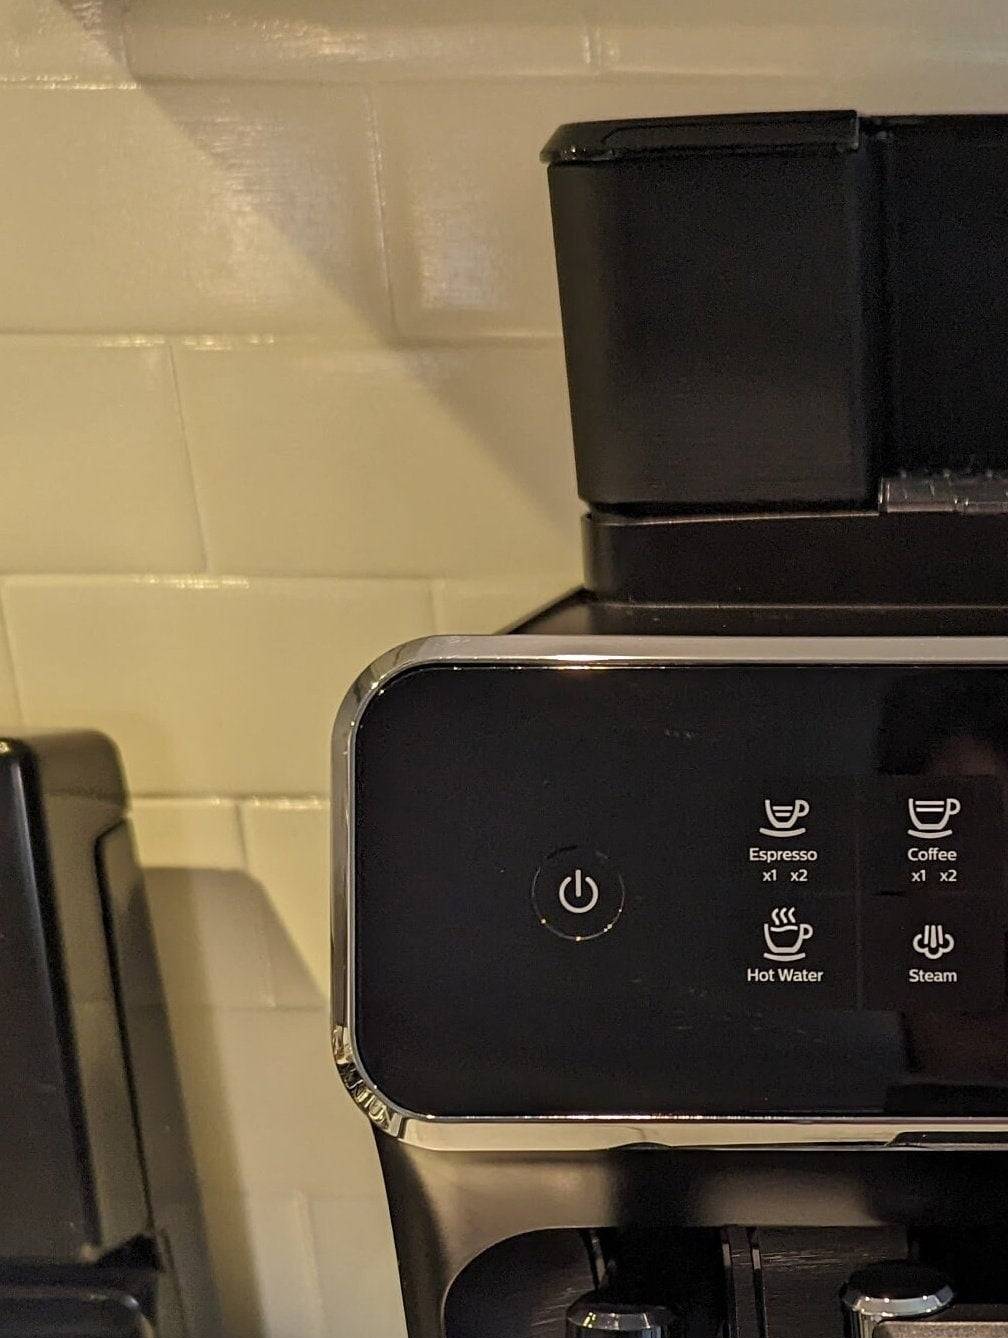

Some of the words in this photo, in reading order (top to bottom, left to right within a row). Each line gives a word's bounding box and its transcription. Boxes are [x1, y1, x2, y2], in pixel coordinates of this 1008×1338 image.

[749, 847, 818, 864] Espresso
[907, 846, 958, 862] Coffee
[762, 868, 777, 882] x1
[790, 868, 808, 882] x2
[911, 869, 926, 882] x1
[939, 869, 958, 882] x2
[747, 968, 775, 982] Hot
[778, 968, 824, 982] Water
[908, 968, 958, 983] Steam
